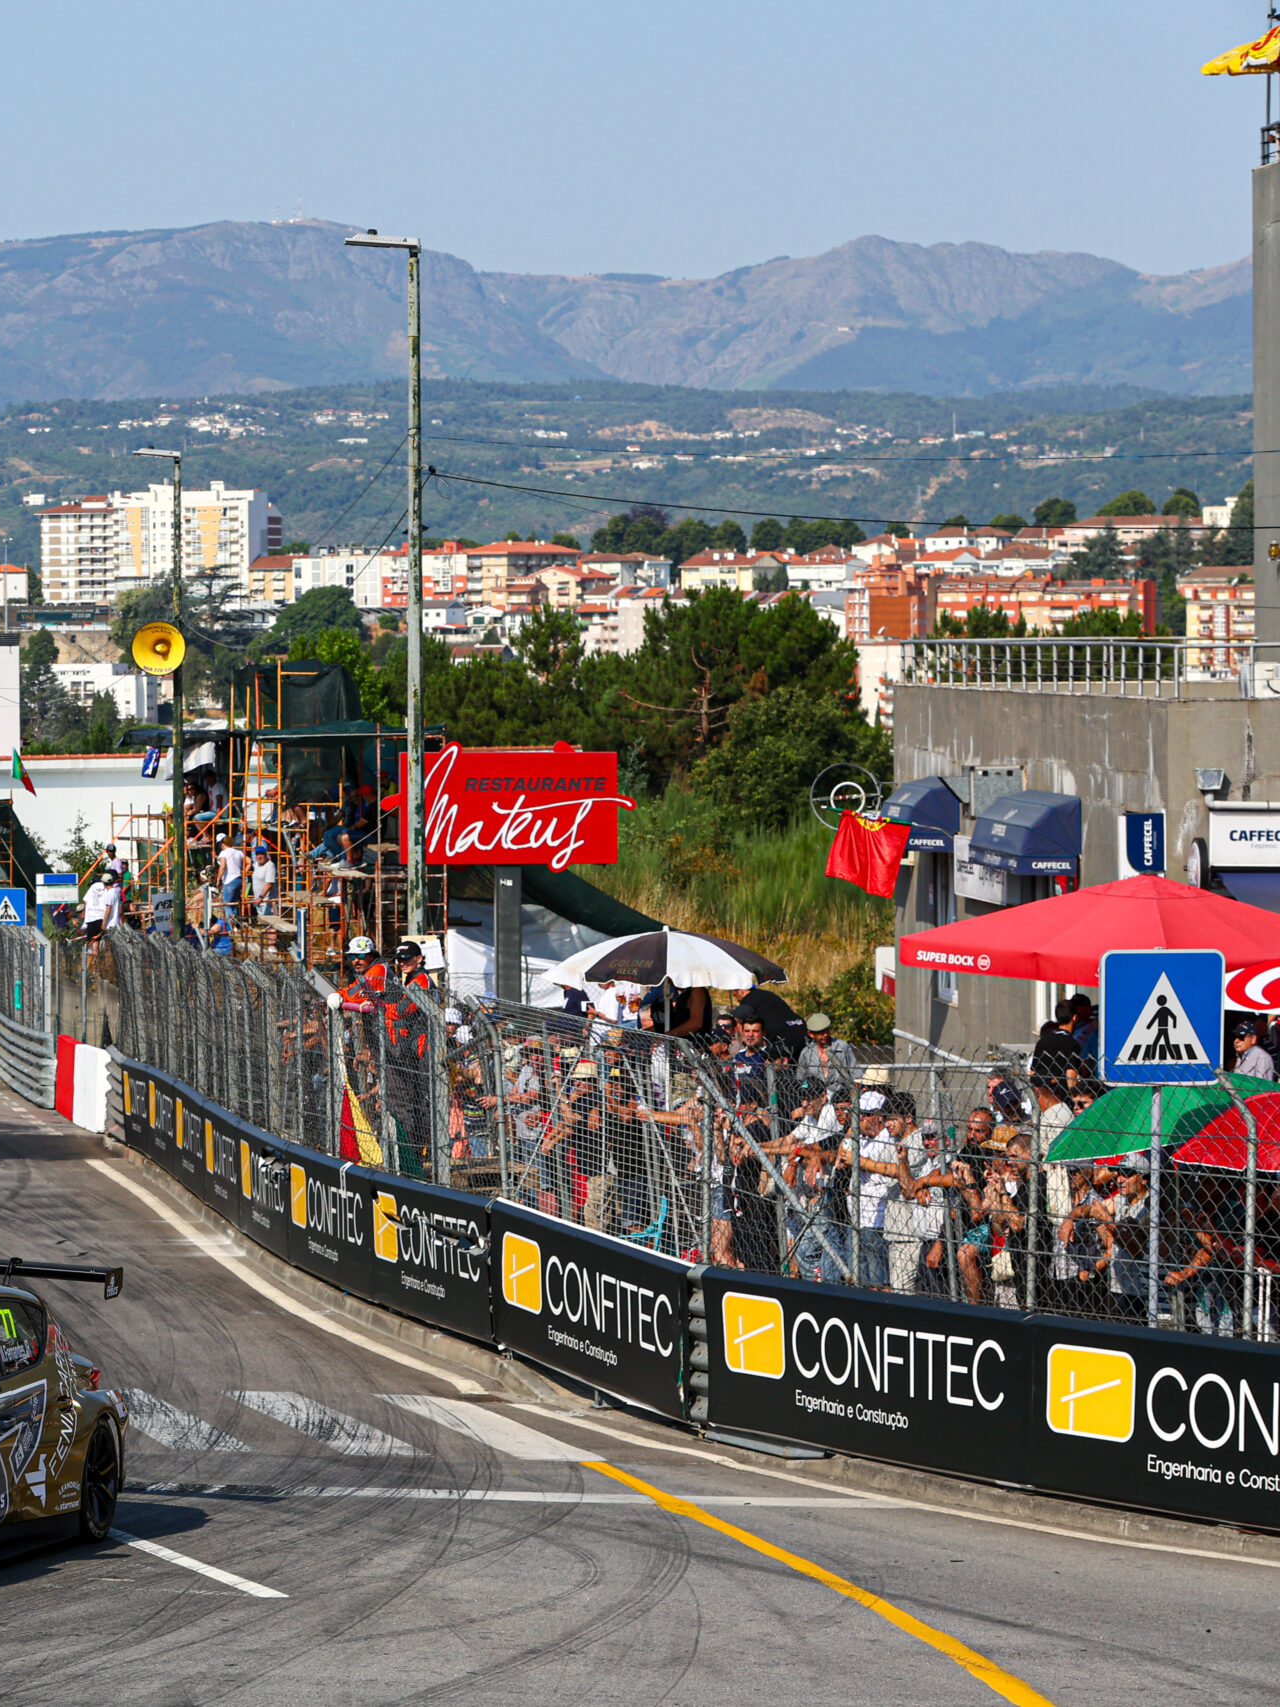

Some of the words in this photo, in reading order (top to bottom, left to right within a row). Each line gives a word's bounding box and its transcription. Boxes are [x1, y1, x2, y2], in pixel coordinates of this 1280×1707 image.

[464, 777, 607, 792] RESTAURANTE
[424, 745, 634, 870] Mateus
[609, 960, 654, 968] GOLDEN
[916, 950, 947, 964] SUPER
[948, 953, 974, 967] BOCK
[308, 1177, 363, 1246] CONFITEC
[399, 1205, 480, 1282] CONFITEC
[401, 1270, 420, 1290] Engenharia
[424, 1279, 445, 1299] Construção
[546, 1255, 673, 1357] CONFITEC
[548, 1325, 579, 1350] Engenharia
[580, 1343, 584, 1352] e
[585, 1340, 618, 1366] Construção
[792, 1312, 1006, 1411] CONFITEC
[795, 1389, 845, 1417] Engenharia
[847, 1407, 854, 1418] e
[856, 1404, 908, 1430] Construção
[1146, 1367, 1280, 1456] CON
[1147, 1454, 1221, 1483] Engenharia
[1226, 1471, 1235, 1484] e
